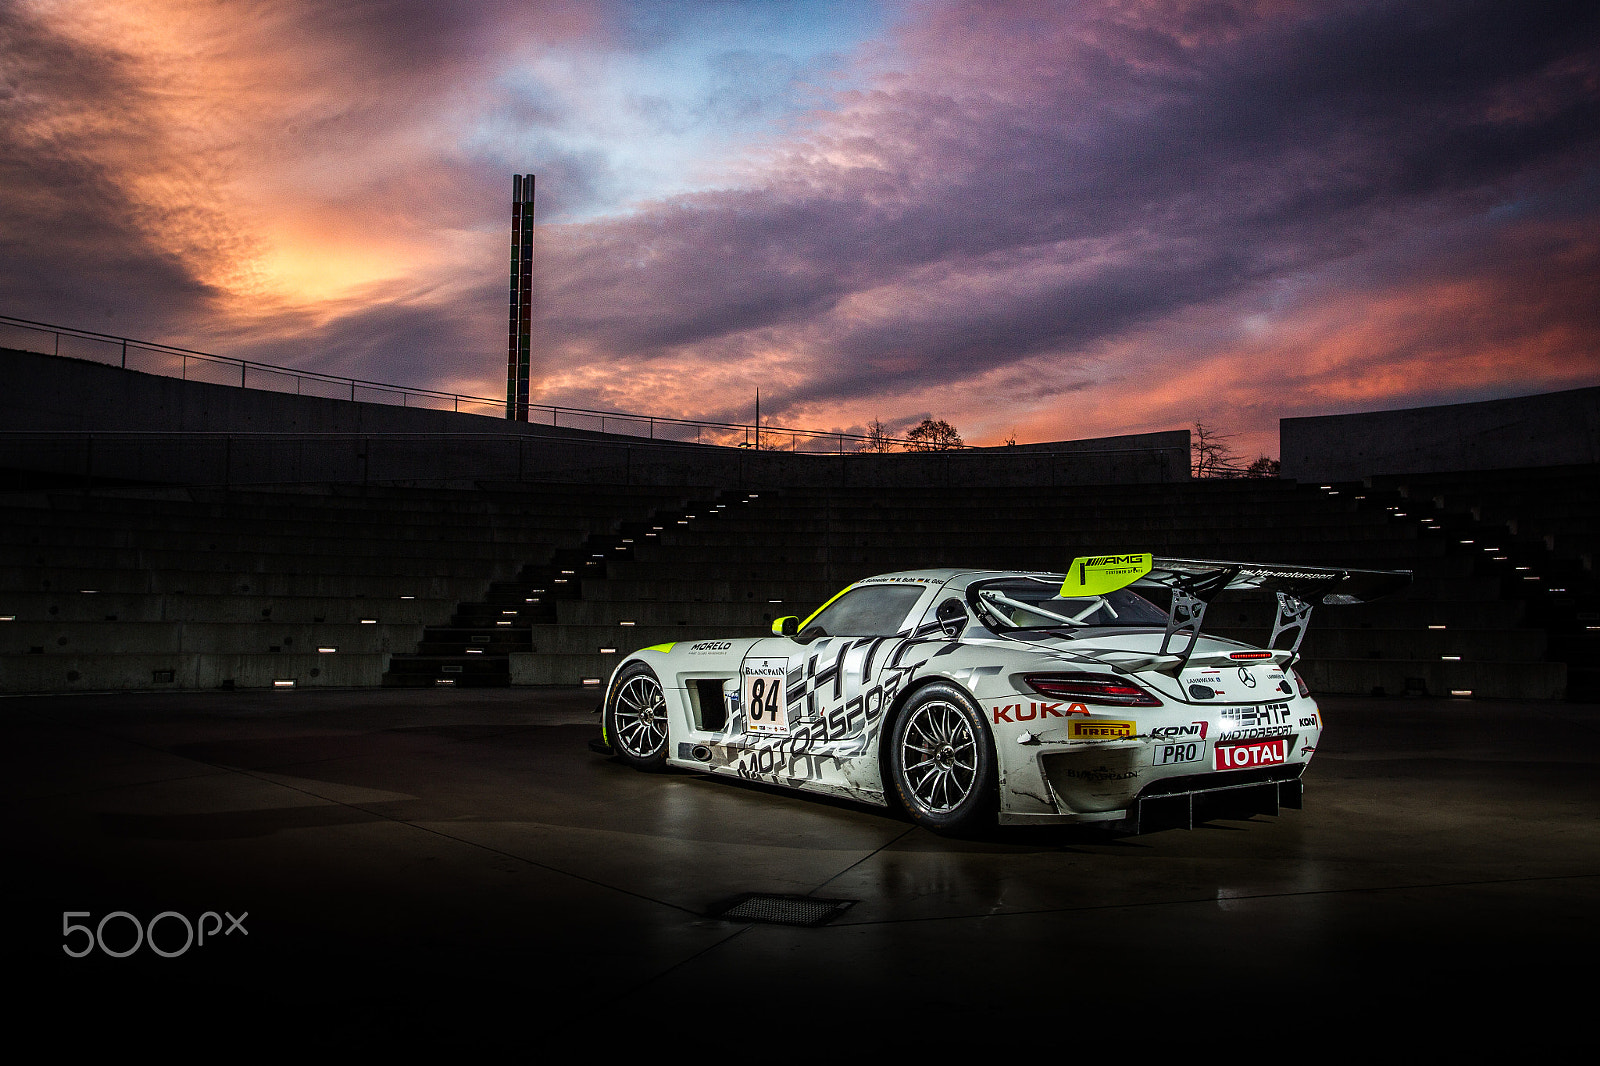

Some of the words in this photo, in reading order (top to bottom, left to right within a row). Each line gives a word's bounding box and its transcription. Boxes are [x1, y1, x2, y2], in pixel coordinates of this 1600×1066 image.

[1102, 555, 1143, 566] AMG
[690, 641, 732, 651] MORELO
[745, 666, 785, 676] BLANCPAIN
[750, 678, 781, 722] 84
[736, 658, 929, 781] MOTORSPORT
[993, 702, 1091, 724] KUKA
[1256, 702, 1291, 726] HTP
[1074, 721, 1133, 738] PIRELLI
[1219, 724, 1293, 742] MOTORSPORT
[1162, 743, 1197, 763] PRO
[1217, 744, 1283, 767] TOTAL
